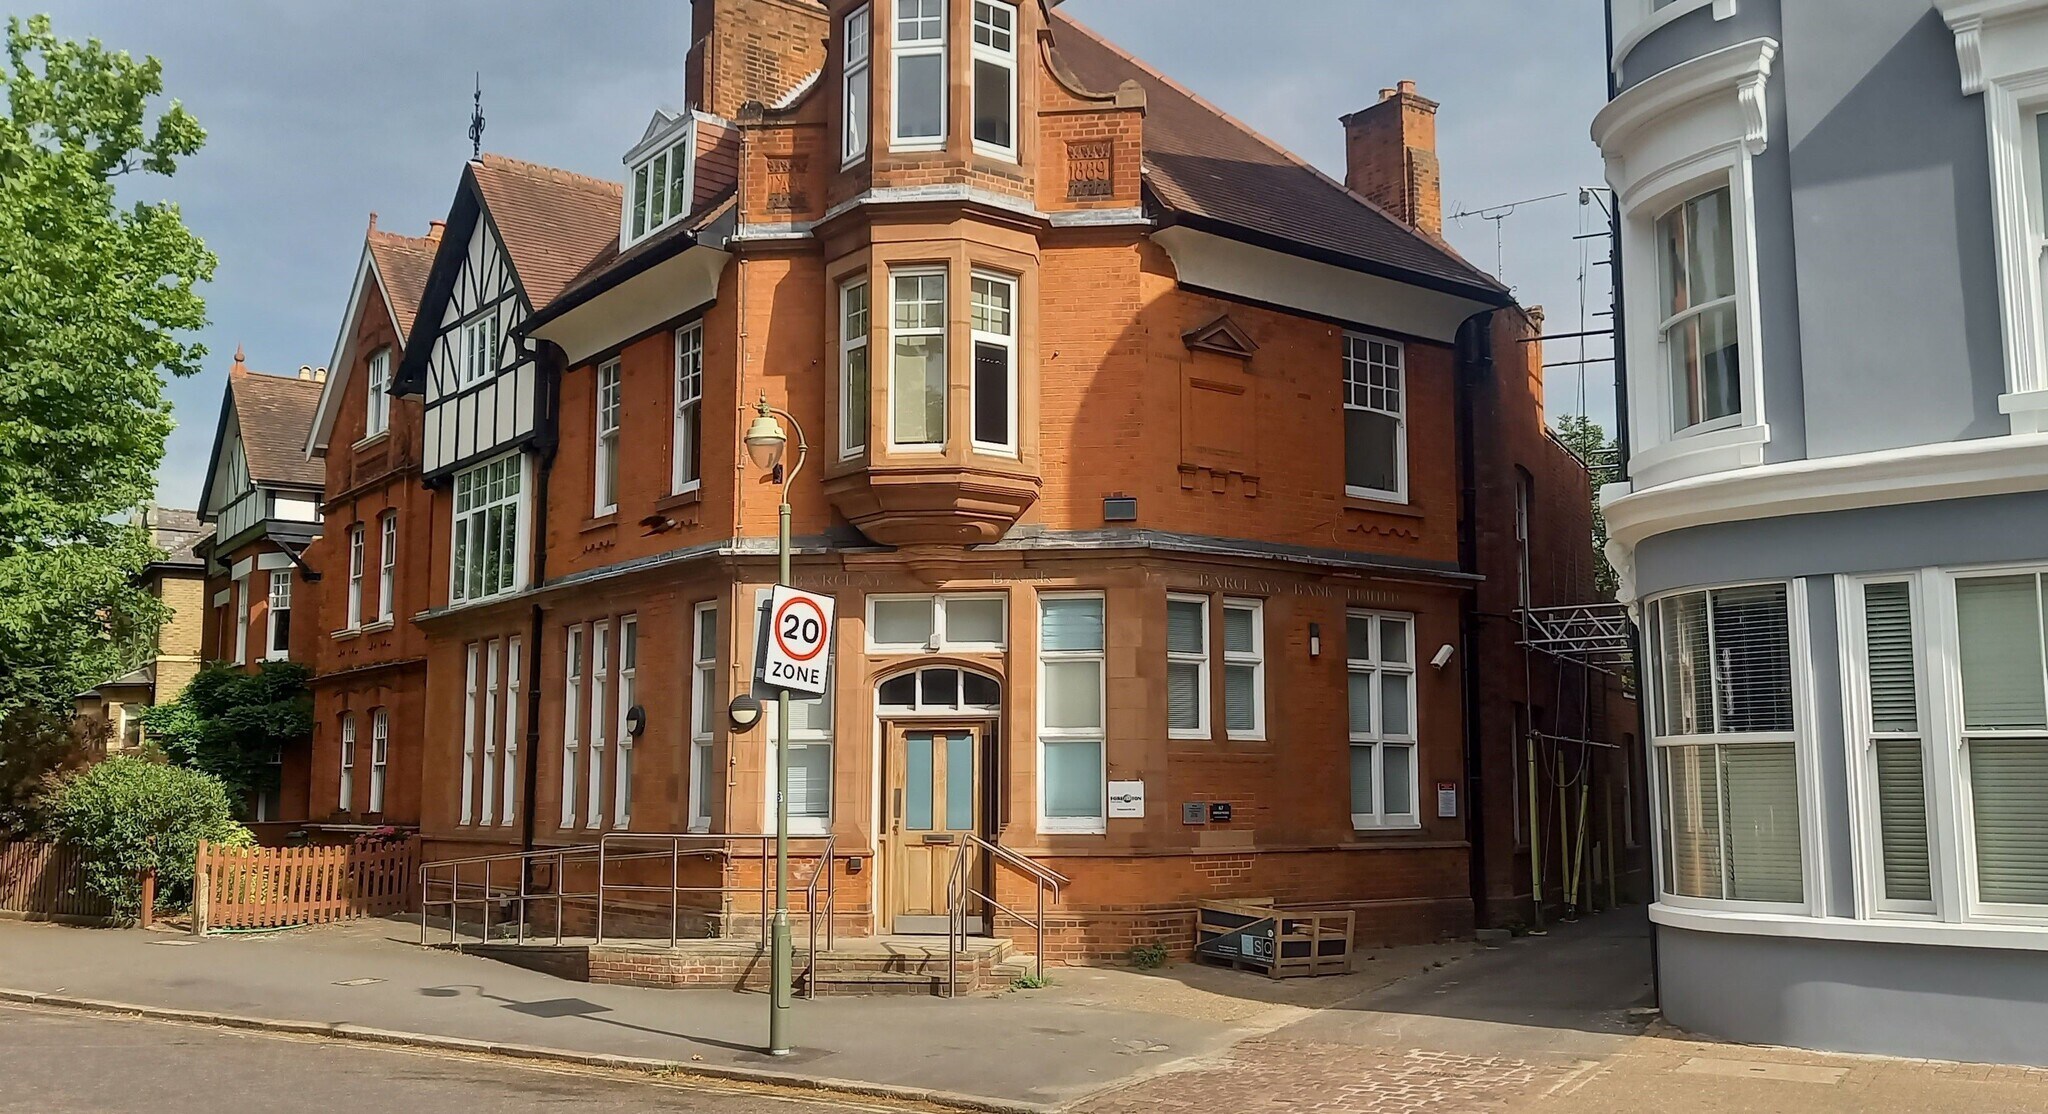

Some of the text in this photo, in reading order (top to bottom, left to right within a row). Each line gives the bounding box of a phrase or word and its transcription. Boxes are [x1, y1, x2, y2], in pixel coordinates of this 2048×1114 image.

[1069, 160, 1105, 181] 1889
[792, 570, 1053, 588] BARCLAY BANK
[1200, 573, 1281, 593] BARCLAYS
[1294, 583, 1333, 597] BANK
[783, 614, 819, 643] 20
[772, 661, 819, 684] ZONE
